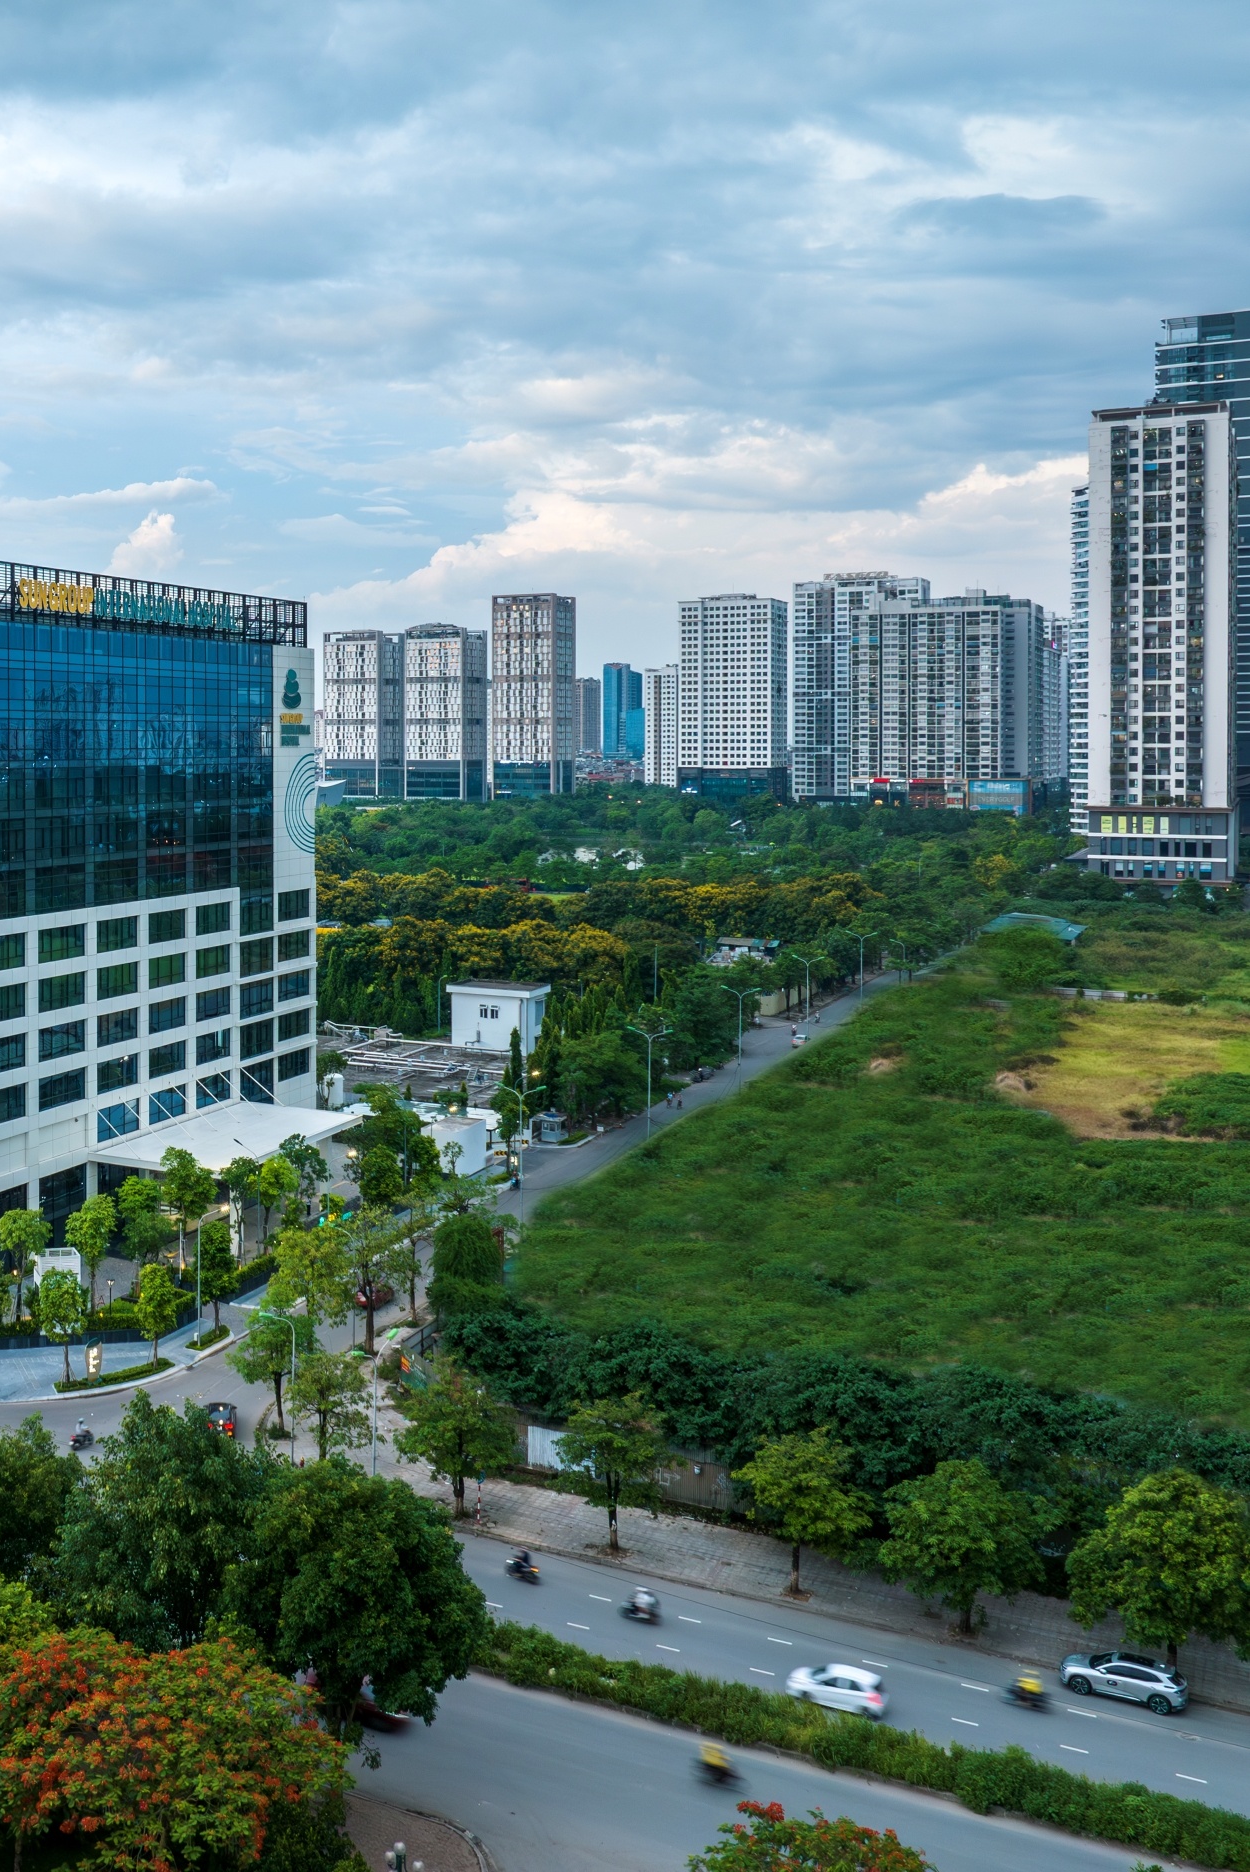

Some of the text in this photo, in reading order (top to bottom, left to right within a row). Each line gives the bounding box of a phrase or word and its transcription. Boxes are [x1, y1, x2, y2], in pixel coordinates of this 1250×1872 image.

[823, 571, 889, 580] TASECO
[94, 586, 186, 625] INTERNATIONAL
[187, 599, 238, 630] HOSPITAL
